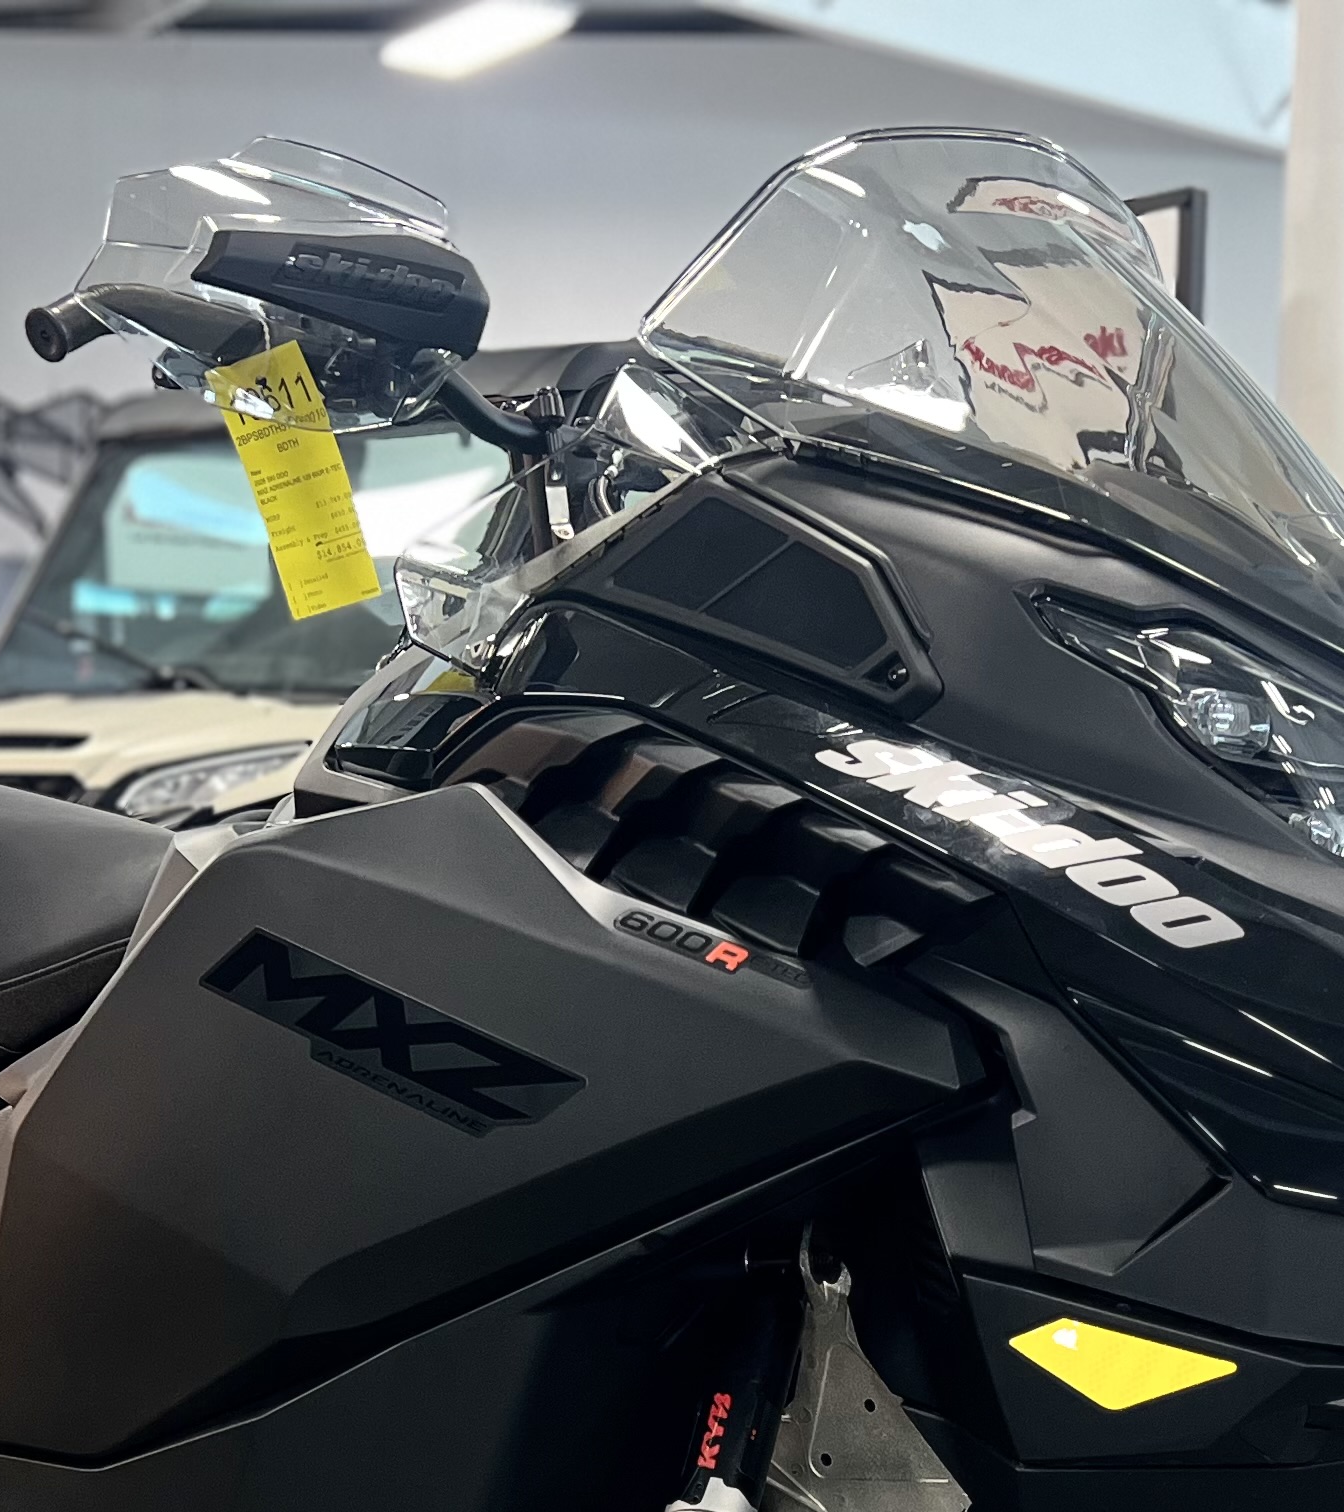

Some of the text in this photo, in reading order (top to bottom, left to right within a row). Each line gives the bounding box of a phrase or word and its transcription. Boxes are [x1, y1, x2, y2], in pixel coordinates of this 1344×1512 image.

[619, 911, 750, 972] 600R
[203, 932, 582, 1121] MXZ
[318, 1048, 489, 1132] ADRENALINE
